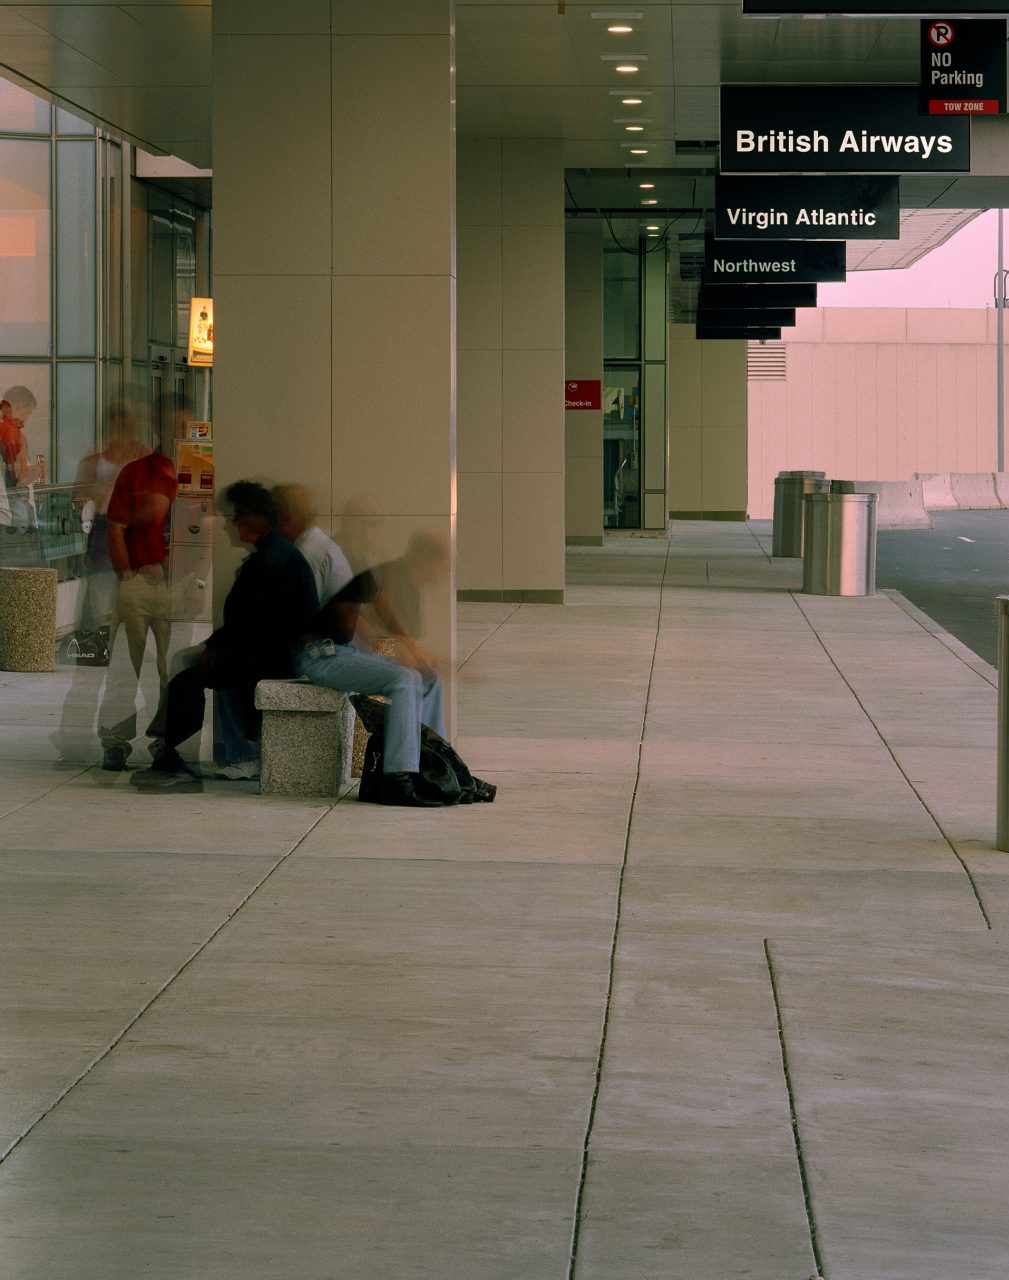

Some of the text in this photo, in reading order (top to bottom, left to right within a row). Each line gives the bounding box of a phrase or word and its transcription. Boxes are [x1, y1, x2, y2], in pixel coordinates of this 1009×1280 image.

[931, 52, 952, 67] NO
[931, 70, 984, 88] Parking
[944, 102, 984, 111] TOW ZONE
[736, 129, 953, 159] British Airways
[726, 208, 877, 230] Virgin Atlantic
[713, 258, 797, 273] Northwest
